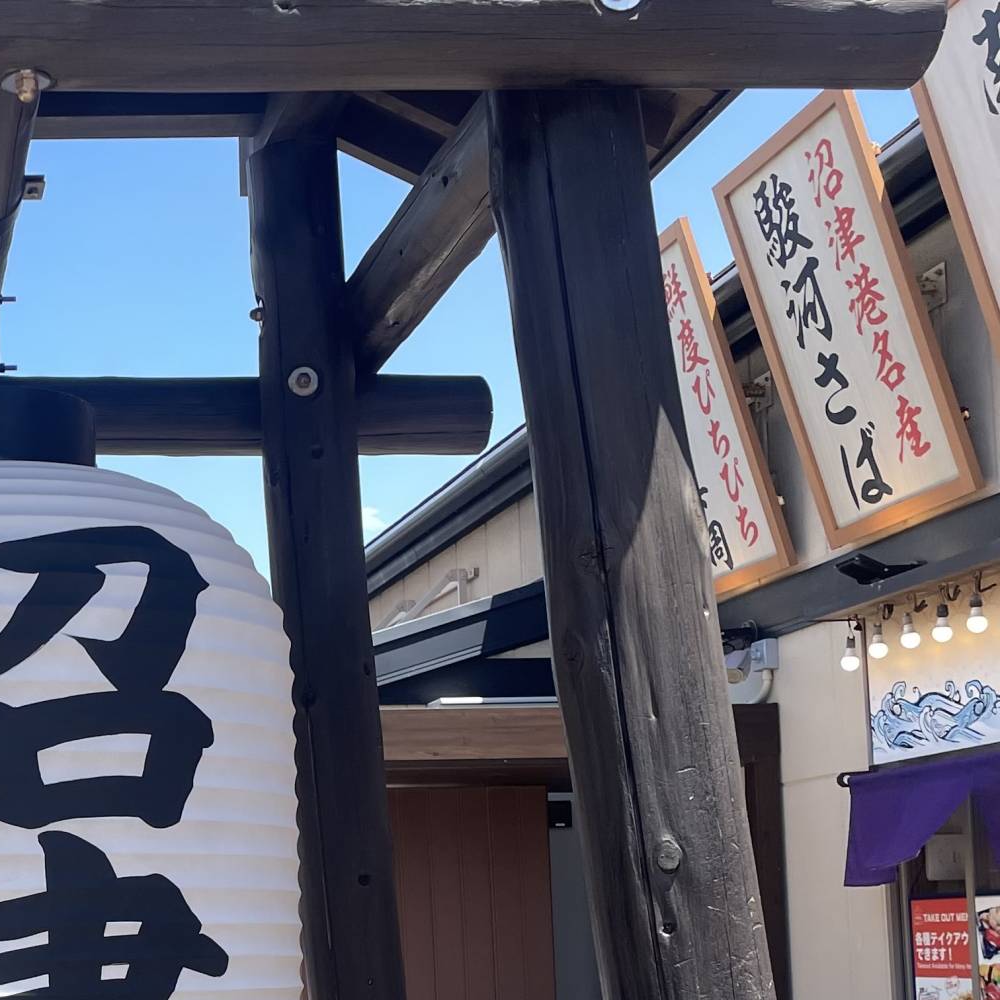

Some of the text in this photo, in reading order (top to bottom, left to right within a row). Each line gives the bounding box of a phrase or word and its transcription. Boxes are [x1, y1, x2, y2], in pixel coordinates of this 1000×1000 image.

[753, 173, 893, 511] 駿河さば
[804, 138, 931, 464] 沼津港名産
